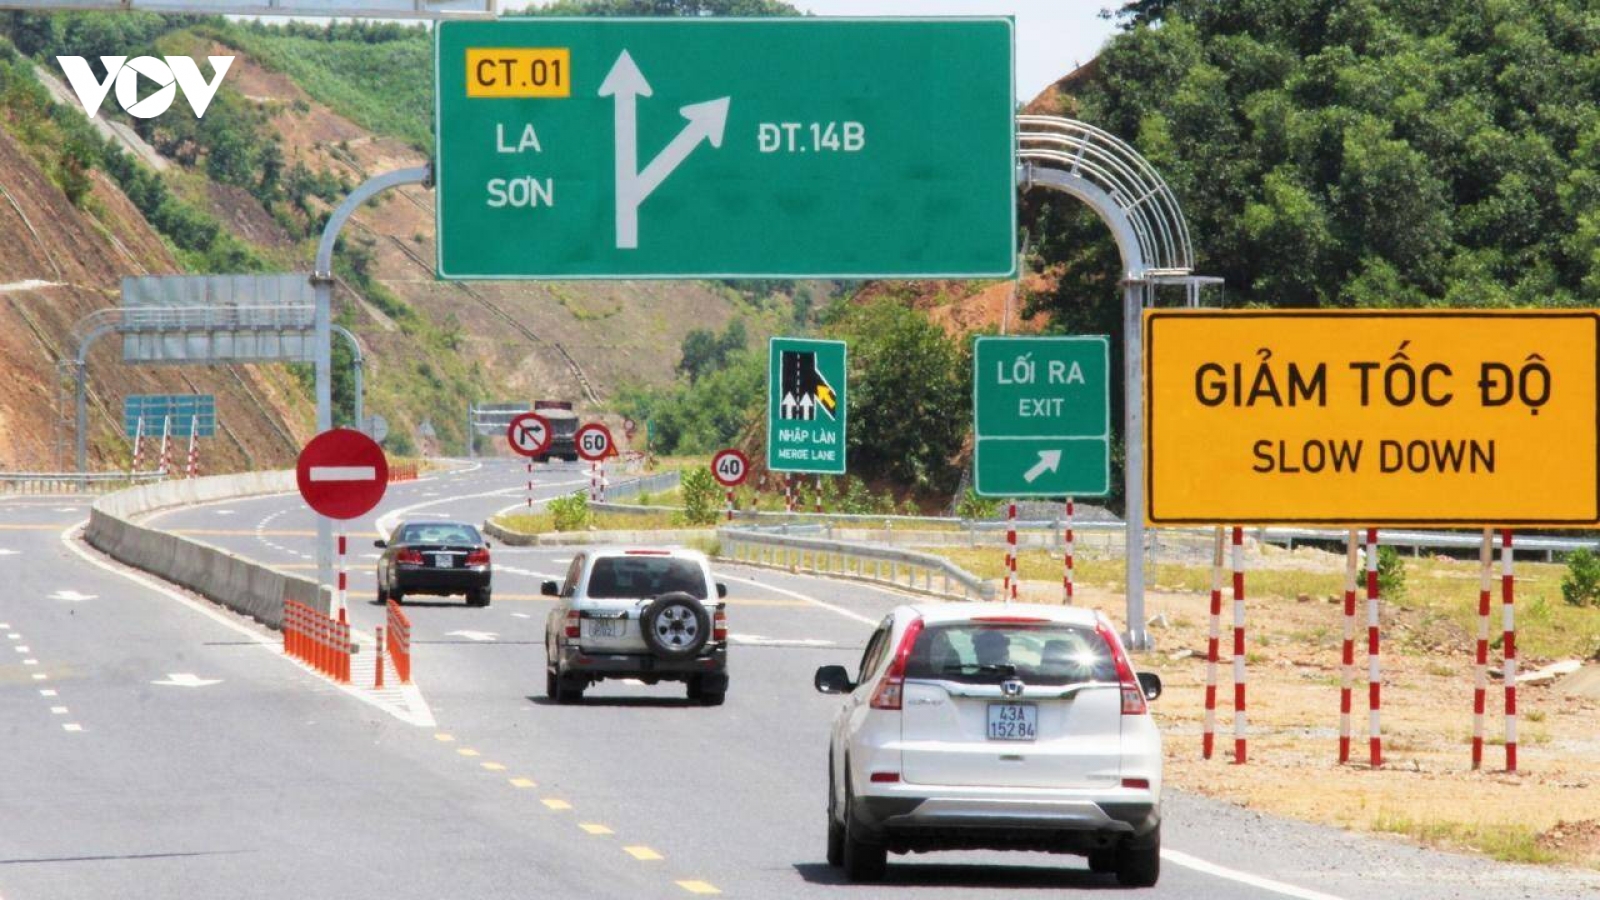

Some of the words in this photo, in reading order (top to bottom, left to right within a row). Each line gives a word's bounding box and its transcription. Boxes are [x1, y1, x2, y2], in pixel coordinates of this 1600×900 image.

[476, 59, 561, 87] CT.01
[496, 123, 542, 153] LA
[757, 121, 865, 152] ĐT.14B
[486, 175, 554, 207] SƠN
[997, 351, 1035, 384] LỐI
[1048, 360, 1085, 384] RA
[1195, 348, 1327, 407] GIẢM
[1349, 340, 1453, 407] TỐC
[1478, 353, 1551, 416] ĐỘ
[1019, 398, 1065, 417] EXIT
[583, 434, 605, 451] 60
[812, 427, 836, 445] LÀN
[719, 459, 740, 475] 40
[779, 449, 809, 460] MERGE
[811, 450, 836, 461] LANE
[1252, 439, 1363, 473] SLOW
[1379, 439, 1495, 473] DOWN
[999, 706, 1025, 721] 43A
